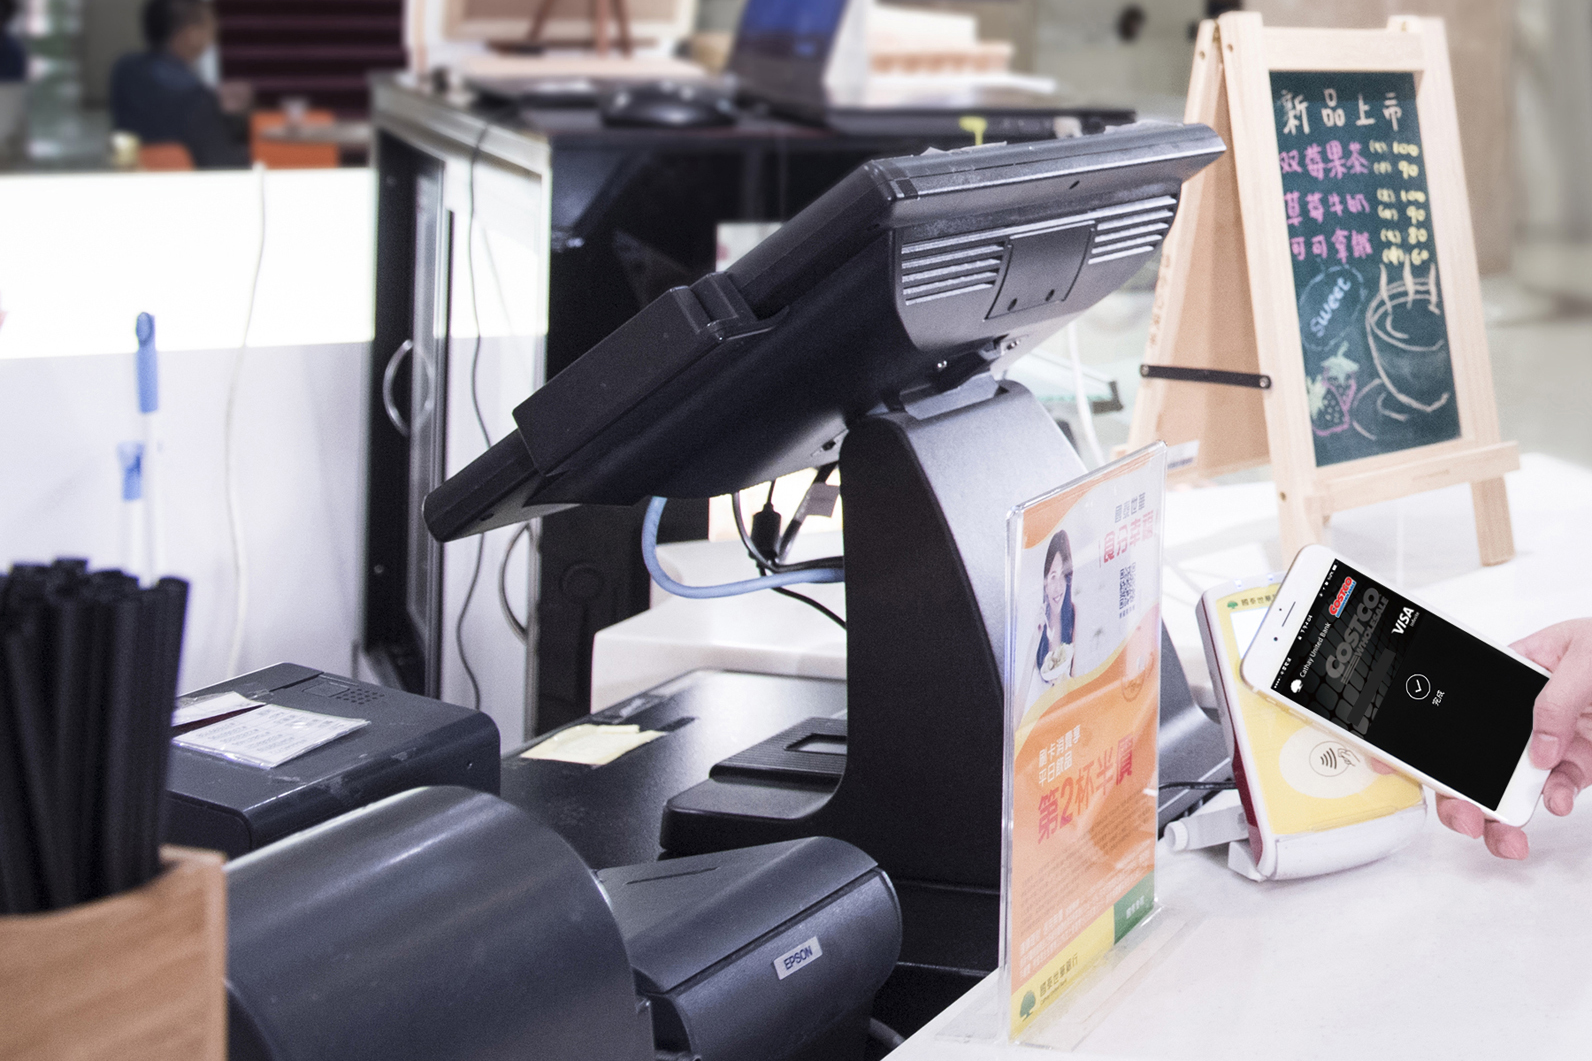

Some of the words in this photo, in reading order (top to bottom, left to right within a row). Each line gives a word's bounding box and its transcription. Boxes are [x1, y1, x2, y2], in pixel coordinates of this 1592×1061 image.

[1280, 89, 1402, 135] 新品上市
[1279, 140, 1369, 179] 双莓果茶
[1392, 141, 1419, 157] 100
[1398, 160, 1419, 179] 90
[1406, 205, 1426, 225] 90
[1329, 576, 1353, 615] COSTCO
[1325, 587, 1379, 678] COSTCO
[1354, 596, 1389, 657] WHOLESALE
[1391, 606, 1414, 634] VISA
[1300, 657, 1314, 678] Cathay
[1310, 637, 1323, 658] United
[1320, 622, 1331, 638] Bank
[1039, 724, 1081, 768] 刷卡消費享
[1039, 750, 1072, 787] 平日飲品
[1038, 733, 1133, 844] 第2杯半價
[784, 945, 813, 970] EPSON
